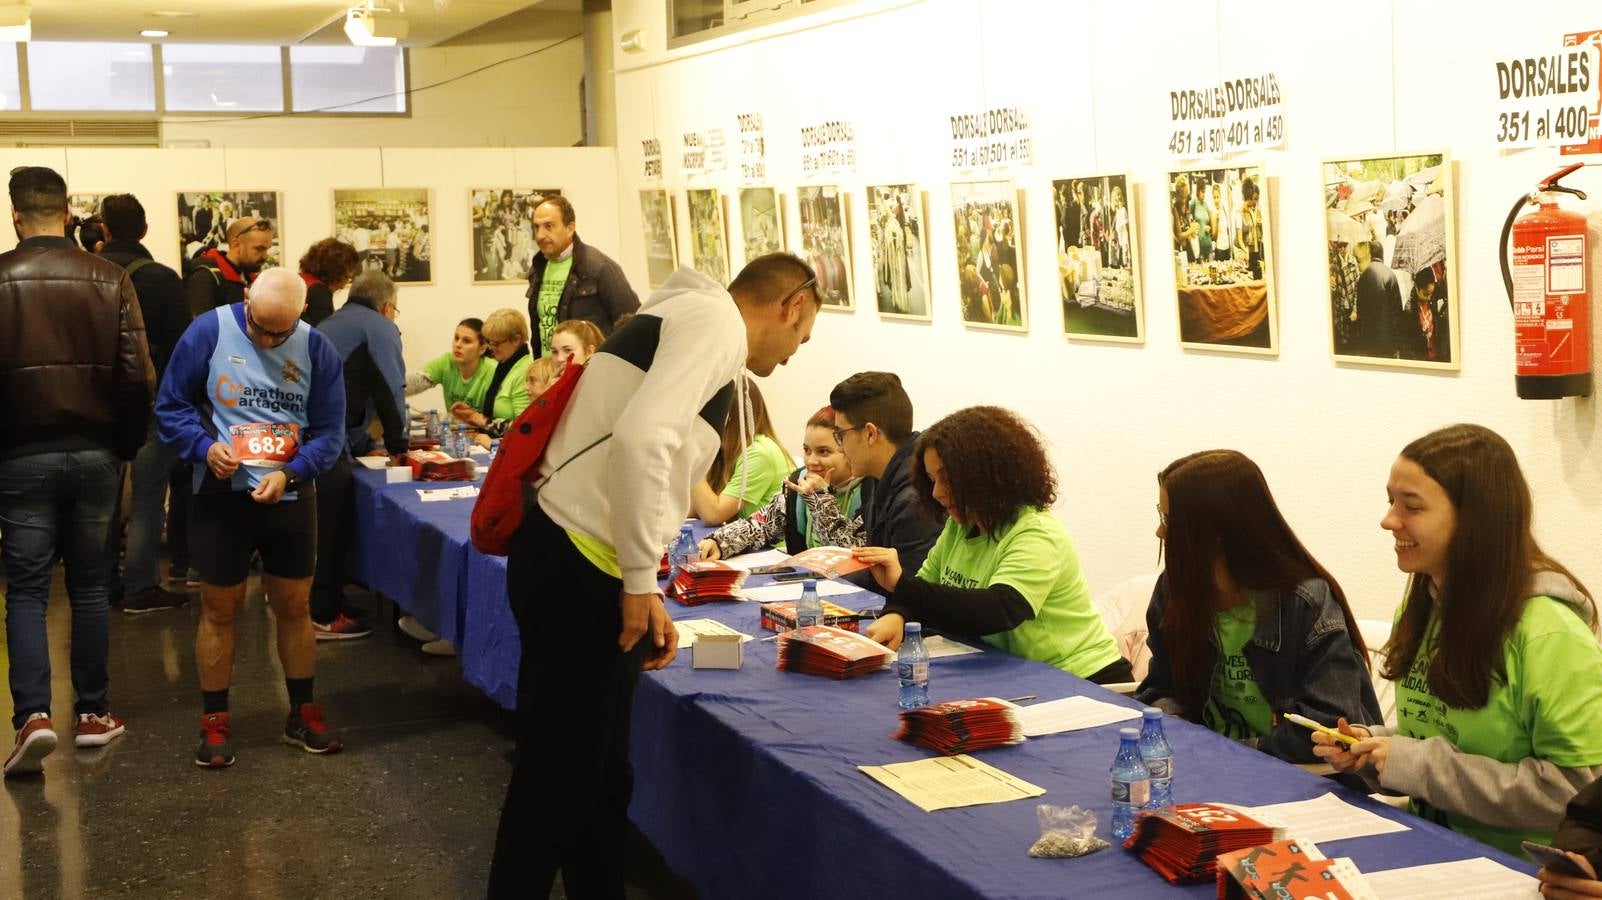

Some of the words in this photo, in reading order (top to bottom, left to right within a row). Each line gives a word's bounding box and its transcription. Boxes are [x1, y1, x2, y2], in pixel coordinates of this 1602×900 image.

[1496, 51, 1590, 99] DORSALES
[1170, 87, 1226, 121] DORSALES
[1225, 73, 1281, 112] DORSALES
[1227, 120, 1249, 146] 401
[1254, 118, 1264, 144] al
[1266, 114, 1283, 141] 450
[1497, 111, 1529, 142] 351
[1537, 109, 1550, 139] al
[1555, 105, 1588, 138] 400
[990, 142, 1008, 163] 501
[1168, 130, 1192, 154] 451
[1196, 129, 1206, 153] al
[952, 147, 968, 167] 551
[229, 383, 304, 402] Marathon
[248, 436, 286, 455] 682
